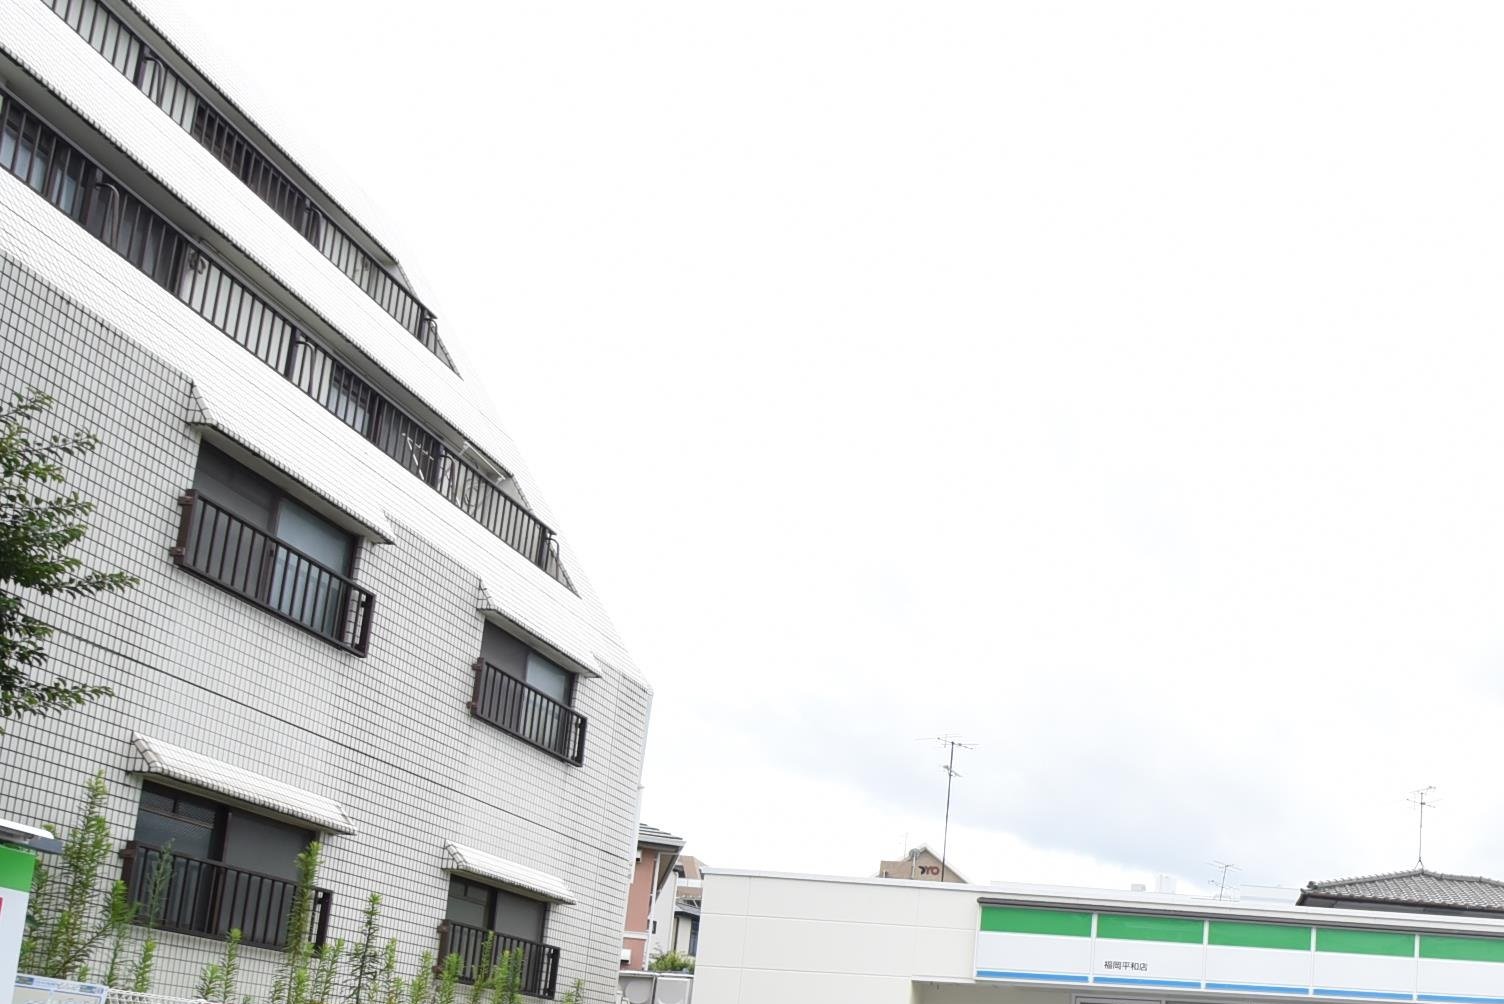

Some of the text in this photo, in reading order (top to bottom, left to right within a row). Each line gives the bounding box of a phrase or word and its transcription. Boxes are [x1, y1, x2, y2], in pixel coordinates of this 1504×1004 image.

[1104, 961, 1148, 971] 福岡平和店
